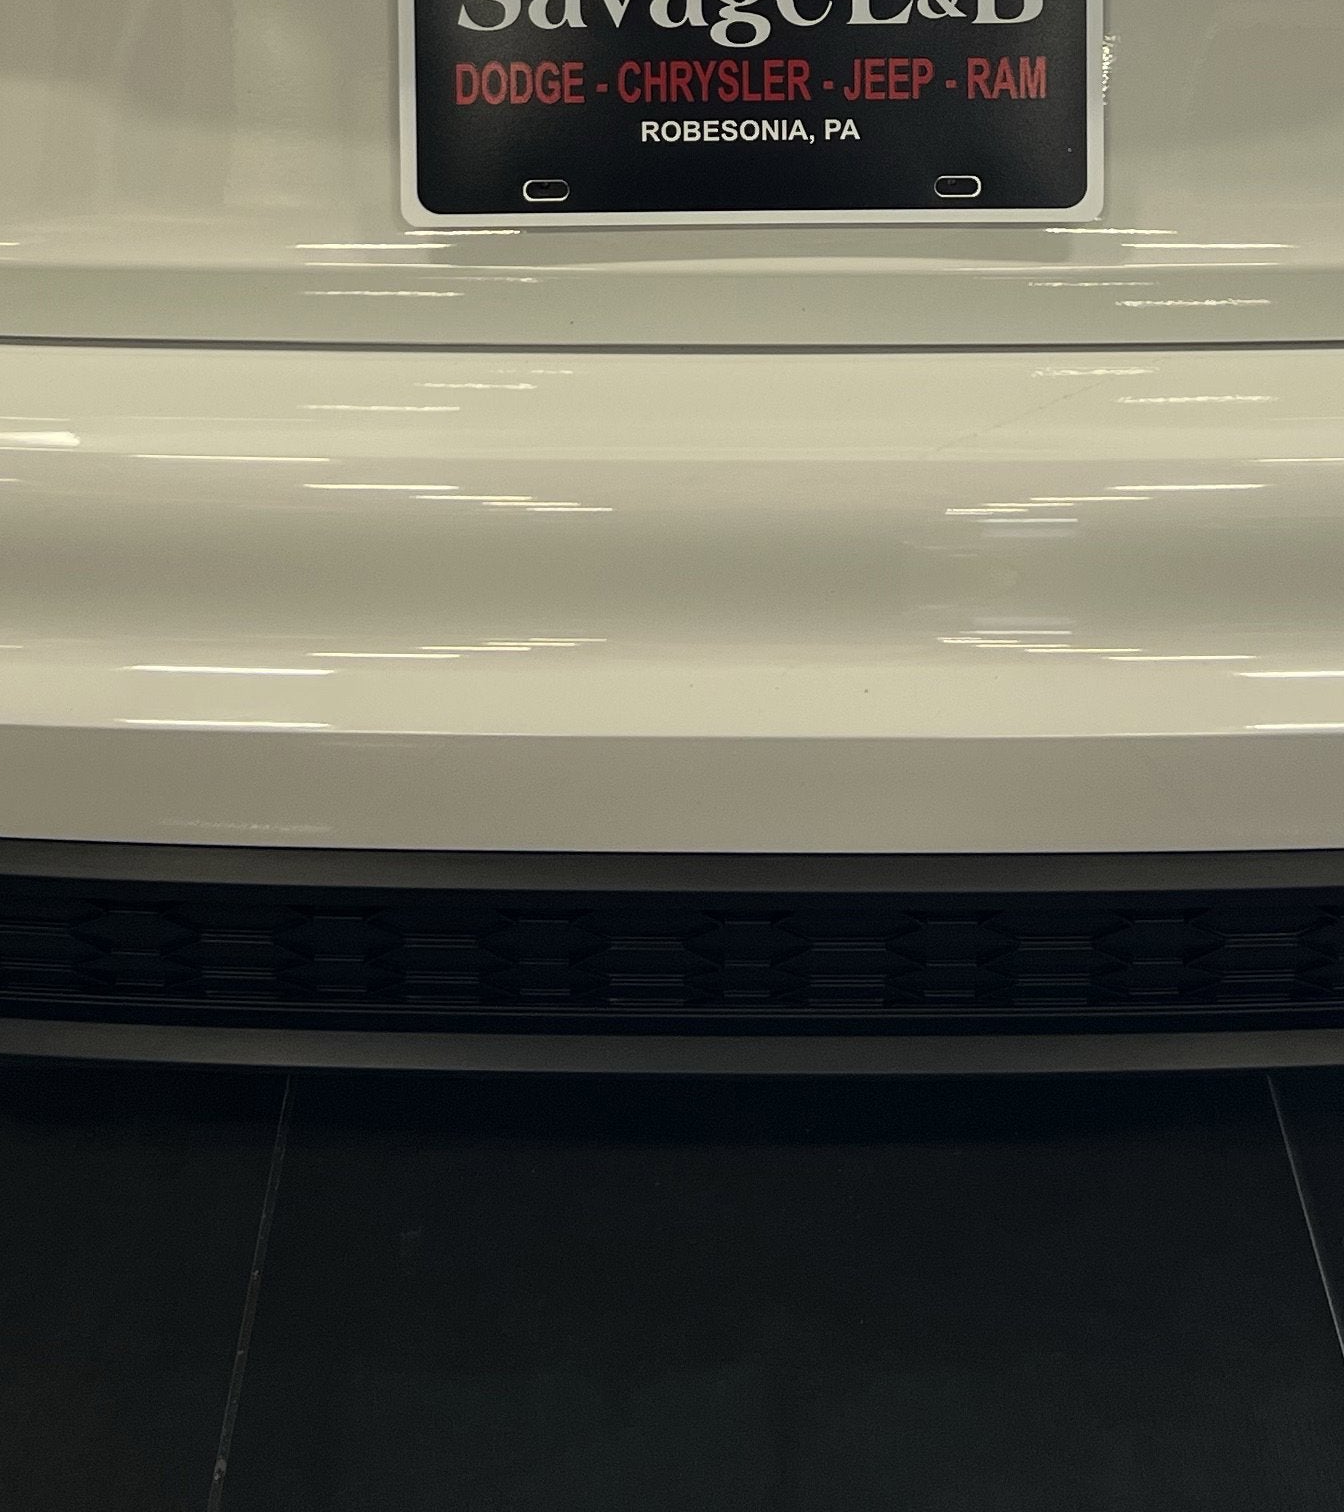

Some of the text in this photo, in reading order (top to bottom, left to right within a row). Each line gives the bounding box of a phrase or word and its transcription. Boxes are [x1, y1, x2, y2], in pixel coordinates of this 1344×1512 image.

[455, 62, 585, 105] DODGE
[617, 59, 811, 104] CHRYSLER
[843, 58, 934, 101] JEEP
[967, 55, 1047, 99] RAM
[641, 118, 861, 144] ROBESONIA, PA
